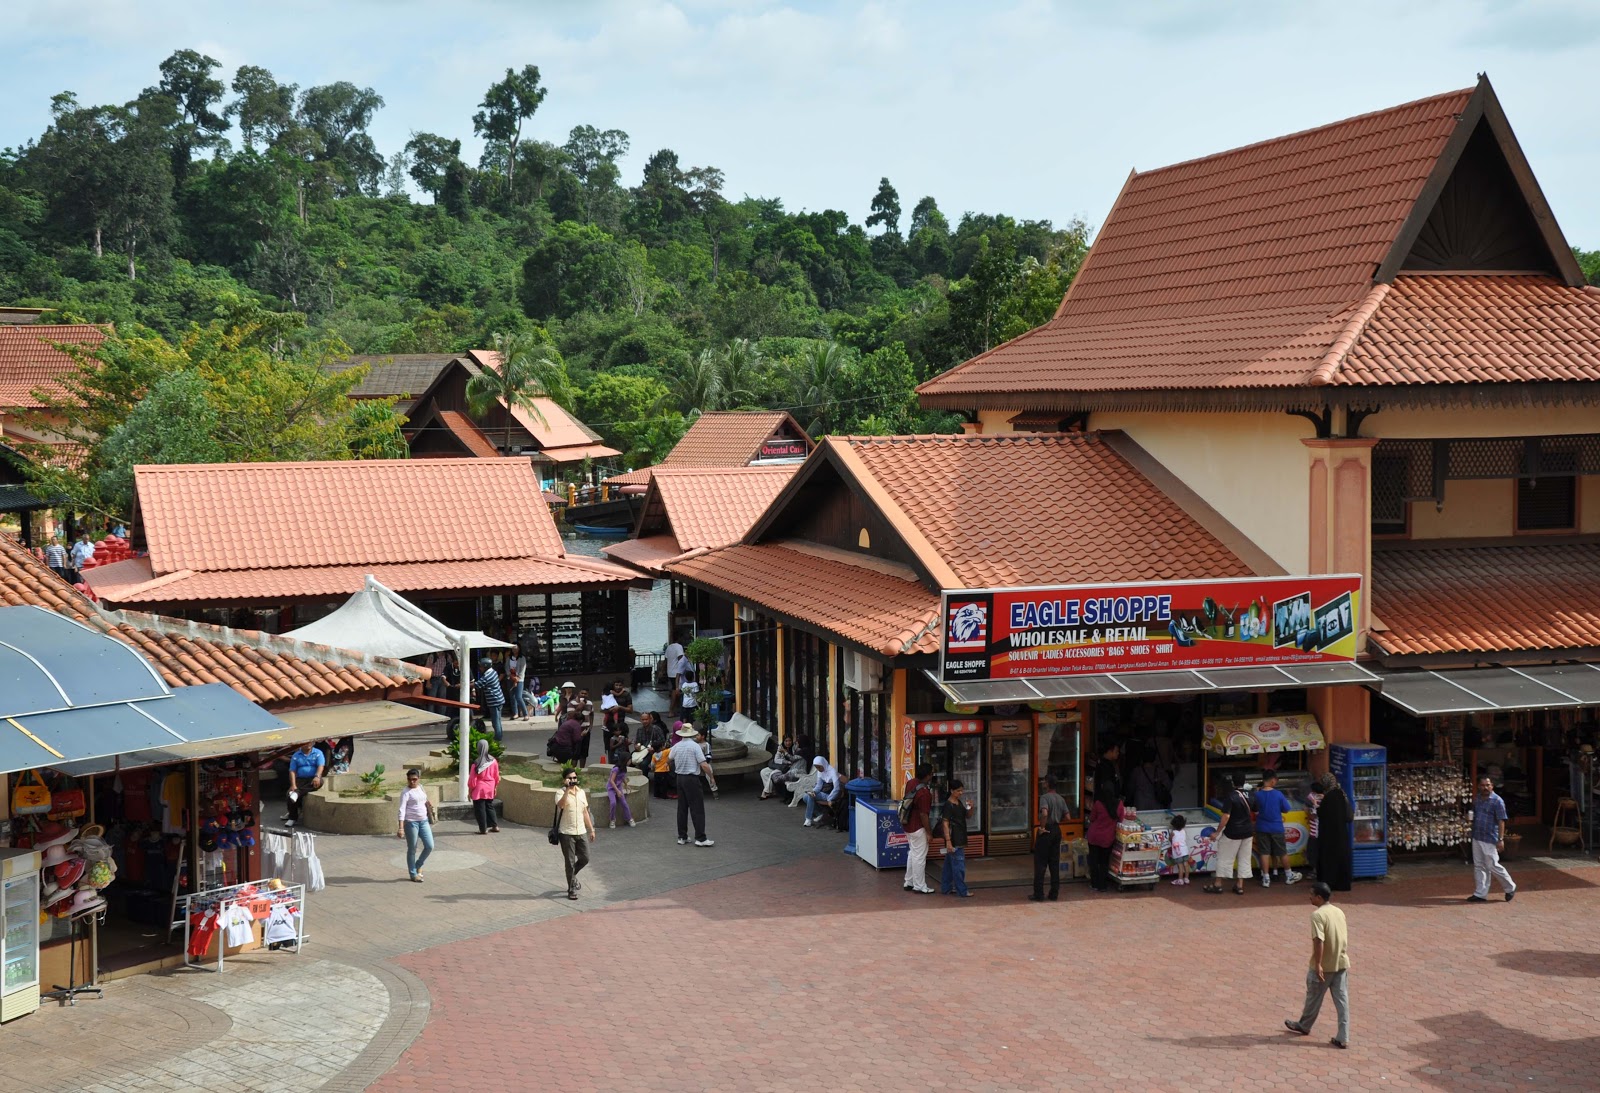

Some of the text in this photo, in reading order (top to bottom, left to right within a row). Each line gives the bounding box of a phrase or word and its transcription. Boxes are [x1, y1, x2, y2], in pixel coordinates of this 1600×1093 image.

[762, 445, 788, 455] Oriental
[1010, 595, 1172, 629] EAGLE SHOPPE
[1009, 626, 1150, 648] WHOLESALE & RETAIL
[1008, 650, 1039, 661] SOUVENIR
[1064, 646, 1105, 658] ACCESSORIES
[1130, 645, 1150, 655] SHOES
[1155, 643, 1174, 654] SHIRT
[946, 660, 986, 669] EAGLE SHOPPE
